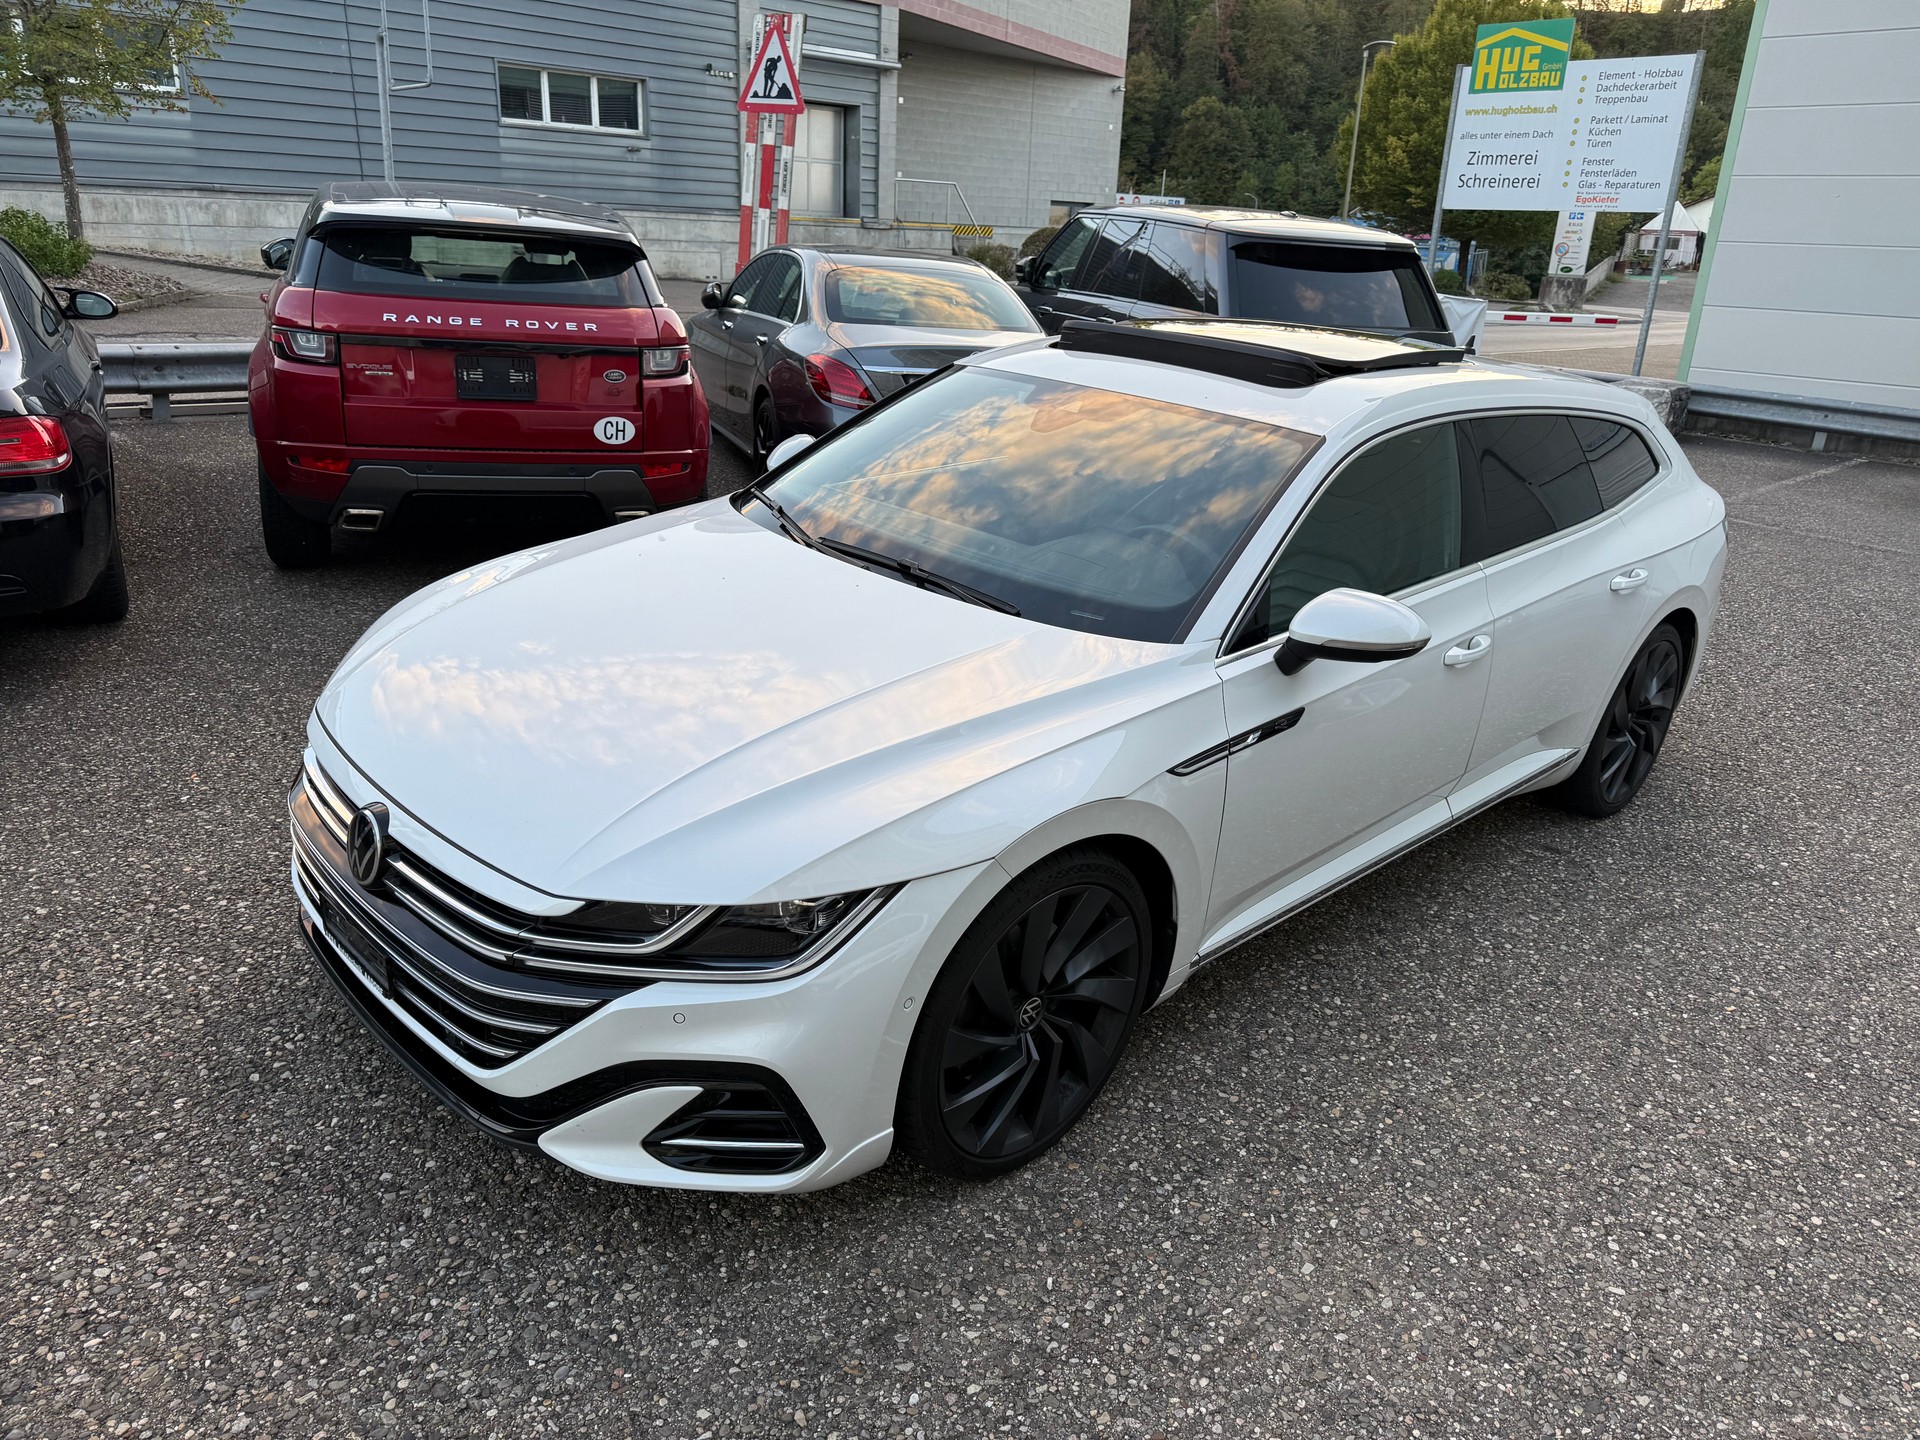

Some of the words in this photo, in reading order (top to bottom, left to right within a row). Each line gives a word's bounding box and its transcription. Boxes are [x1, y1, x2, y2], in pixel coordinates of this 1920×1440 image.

[1474, 46, 1542, 89] HUG
[1542, 62, 1562, 71] GmbH
[1598, 71, 1635, 81] Element
[1644, 69, 1684, 79] Holzbau
[1596, 81, 1677, 93] Dachdeckerarbeit
[1594, 94, 1648, 106] Treppenbau
[1465, 104, 1558, 117] www.hugholzbau.ch
[1590, 115, 1623, 125] Parkett
[1630, 114, 1669, 124] Laminat
[1460, 132, 1478, 140] alles
[1480, 132, 1503, 140] unter
[1504, 131, 1530, 139] einem
[1532, 130, 1554, 139] Dach
[1588, 127, 1622, 136] Küchen
[1586, 138, 1612, 148] Türen
[1466, 150, 1539, 166] Zimmerei
[1582, 157, 1615, 166] Fenster
[1579, 168, 1637, 178] Fensterläden
[1458, 173, 1541, 189] Schreinerei
[1578, 180, 1597, 189] Glas
[1604, 180, 1661, 191] Reparaturen
[1576, 195, 1620, 205] EgoKiefer
[383, 313, 482, 326] RANGE
[505, 319, 597, 332] ROVER
[604, 421, 626, 441] CH
